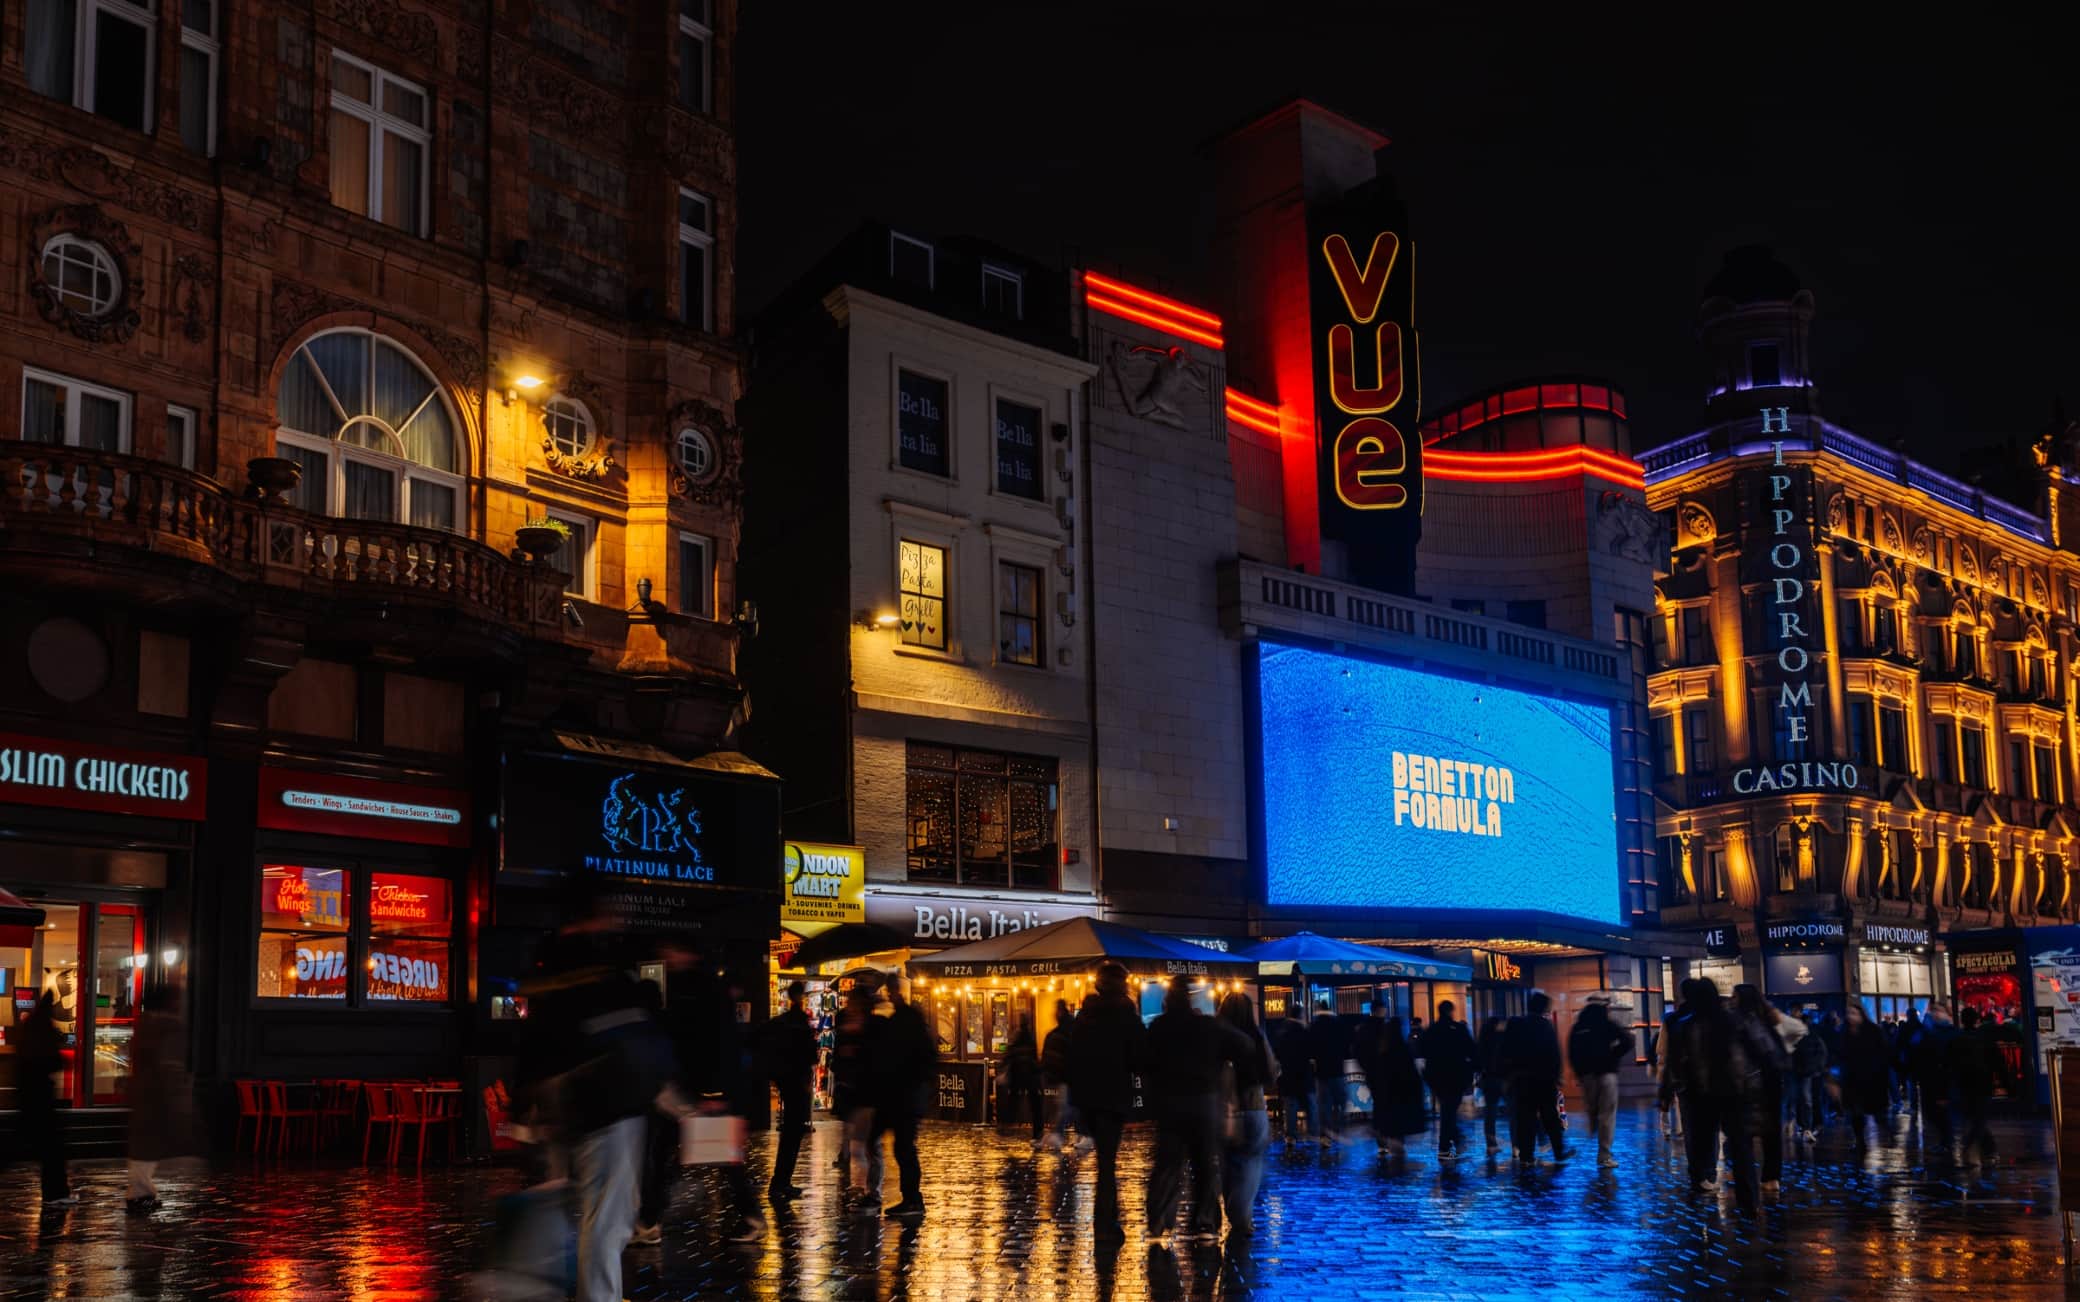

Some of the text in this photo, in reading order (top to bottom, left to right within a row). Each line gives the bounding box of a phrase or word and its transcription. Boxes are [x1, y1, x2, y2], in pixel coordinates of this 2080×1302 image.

[900, 391, 940, 421] Bella
[899, 427, 938, 456] Italia
[998, 417, 1034, 447] Bella
[901, 544, 936, 569] Pizza
[902, 567, 935, 589] Pasta
[1760, 406, 1816, 743] HIPPODROME
[905, 599, 934, 617] Grill
[0, 748, 189, 801] SLIM CHICKENS
[1392, 751, 1515, 803] BENETTON
[1733, 762, 1858, 794] CASINO
[291, 793, 316, 806] Tenders
[322, 798, 342, 809] Wings
[347, 800, 385, 813] Sandwiches
[1393, 788, 1502, 837] FORMULA
[585, 855, 714, 881] PLATINUM LACE
[802, 853, 849, 877] NDON
[792, 875, 840, 898] MART
[277, 895, 312, 913] Wings
[371, 901, 427, 919] Sandwiches
[788, 908, 819, 917] TOBACCO
[796, 900, 833, 910] SOUVENIRS
[837, 903, 860, 912] DRINKS
[914, 905, 1052, 941] Bella Itali
[1767, 922, 1845, 940] HIPPODROME
[1865, 924, 1929, 945] HIPPODROME
[944, 962, 1060, 976] PIZZA PASTA GRILL
[1166, 959, 1208, 975] Bella Italia
[938, 1073, 966, 1091] Bella
[938, 1092, 966, 1109] Italia
